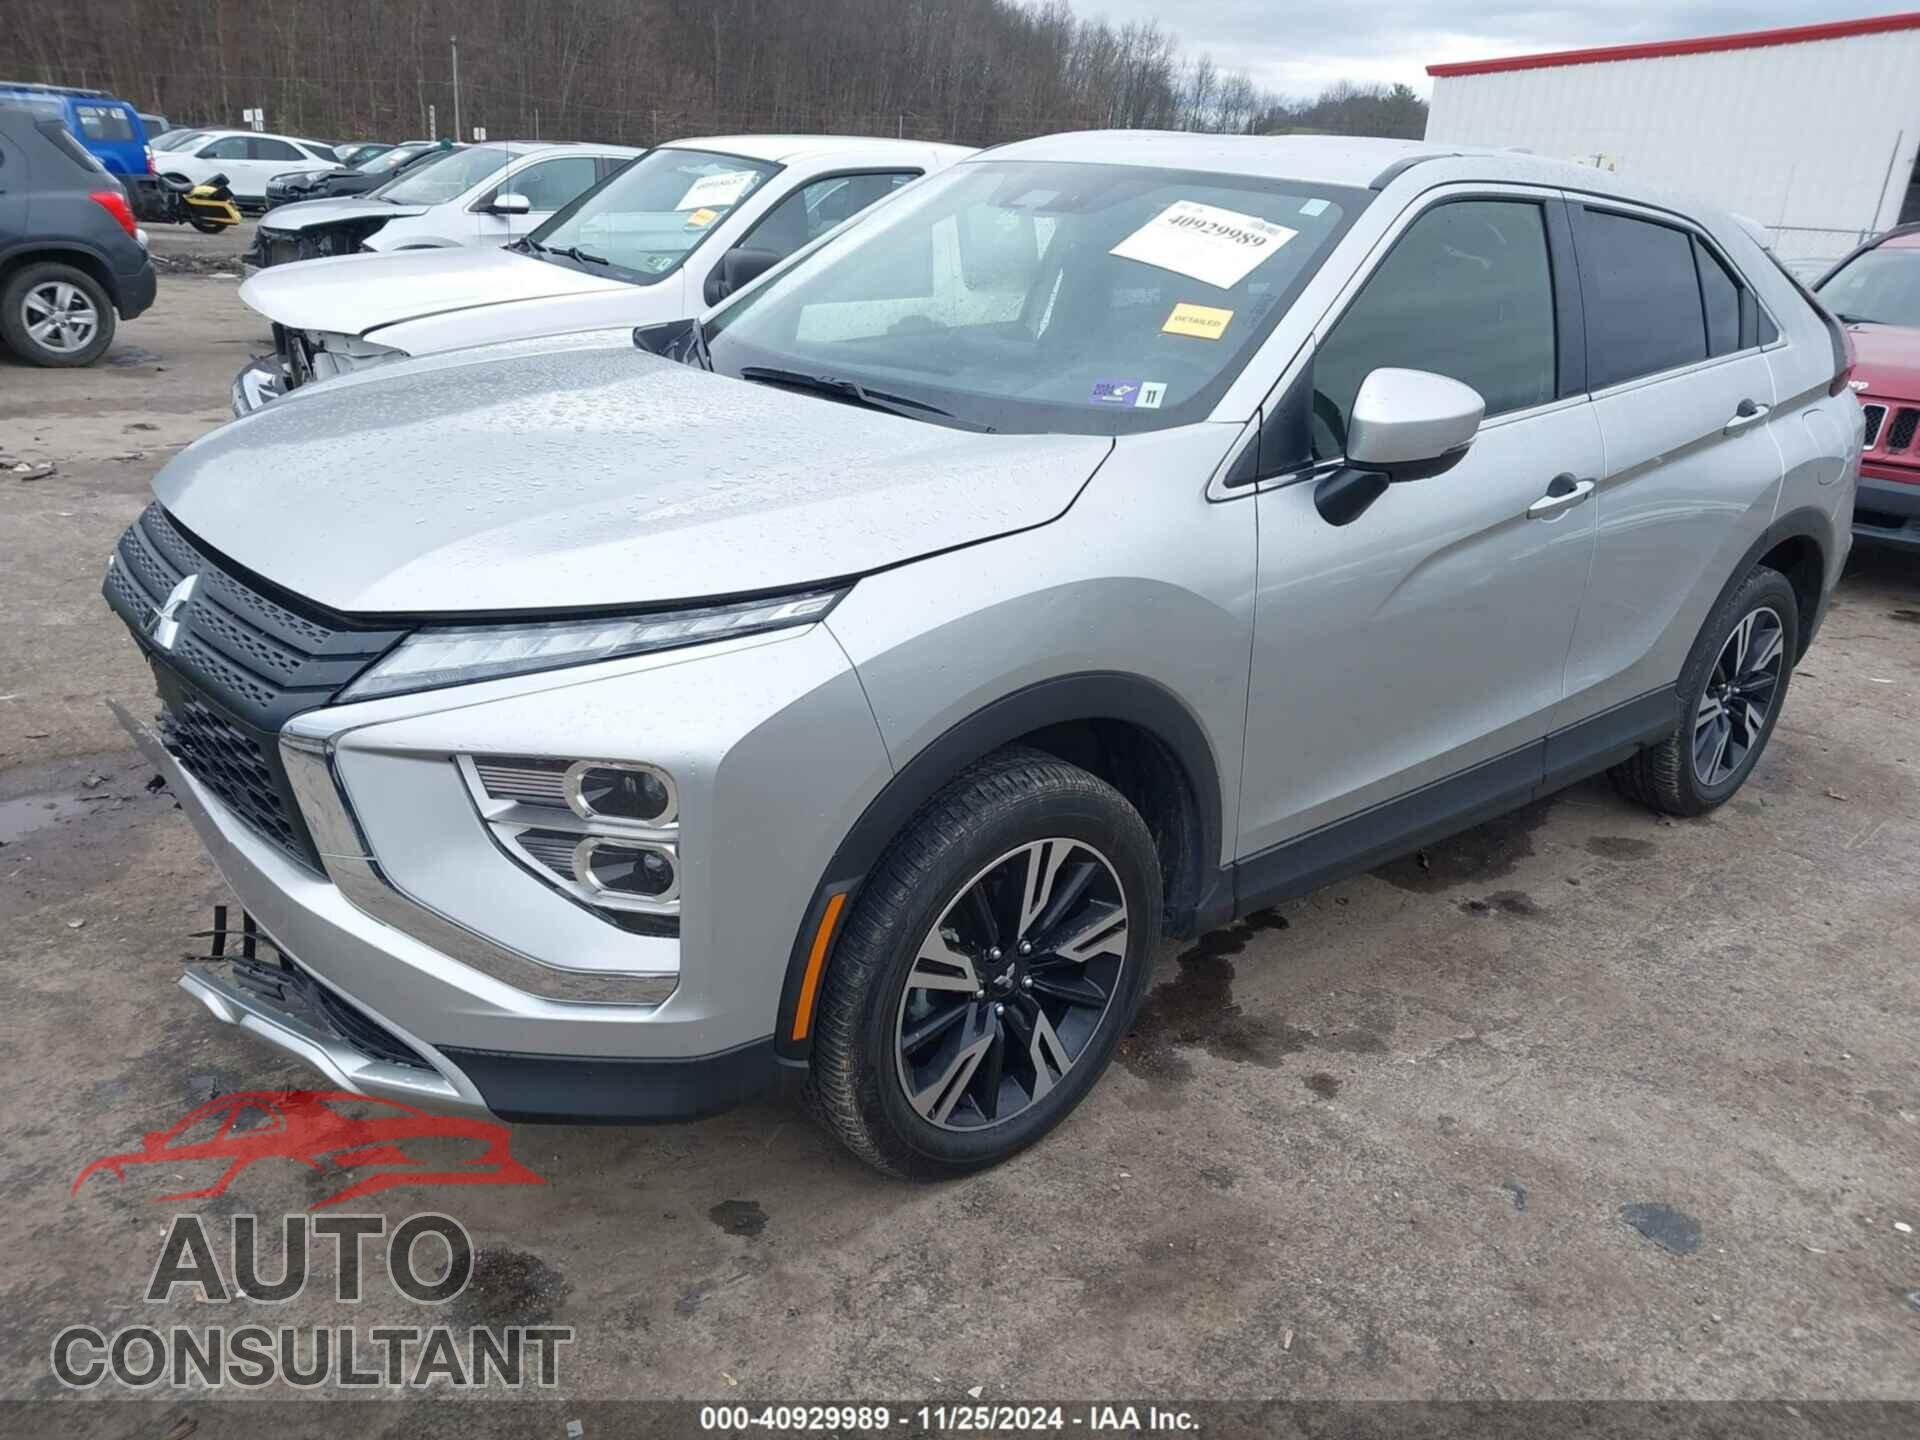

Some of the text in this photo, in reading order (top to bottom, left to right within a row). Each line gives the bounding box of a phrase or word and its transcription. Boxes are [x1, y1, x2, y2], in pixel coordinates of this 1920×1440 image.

[1168, 215, 1267, 247] 40929989
[1848, 380, 1869, 391] ep
[1145, 389, 1157, 404] 11
